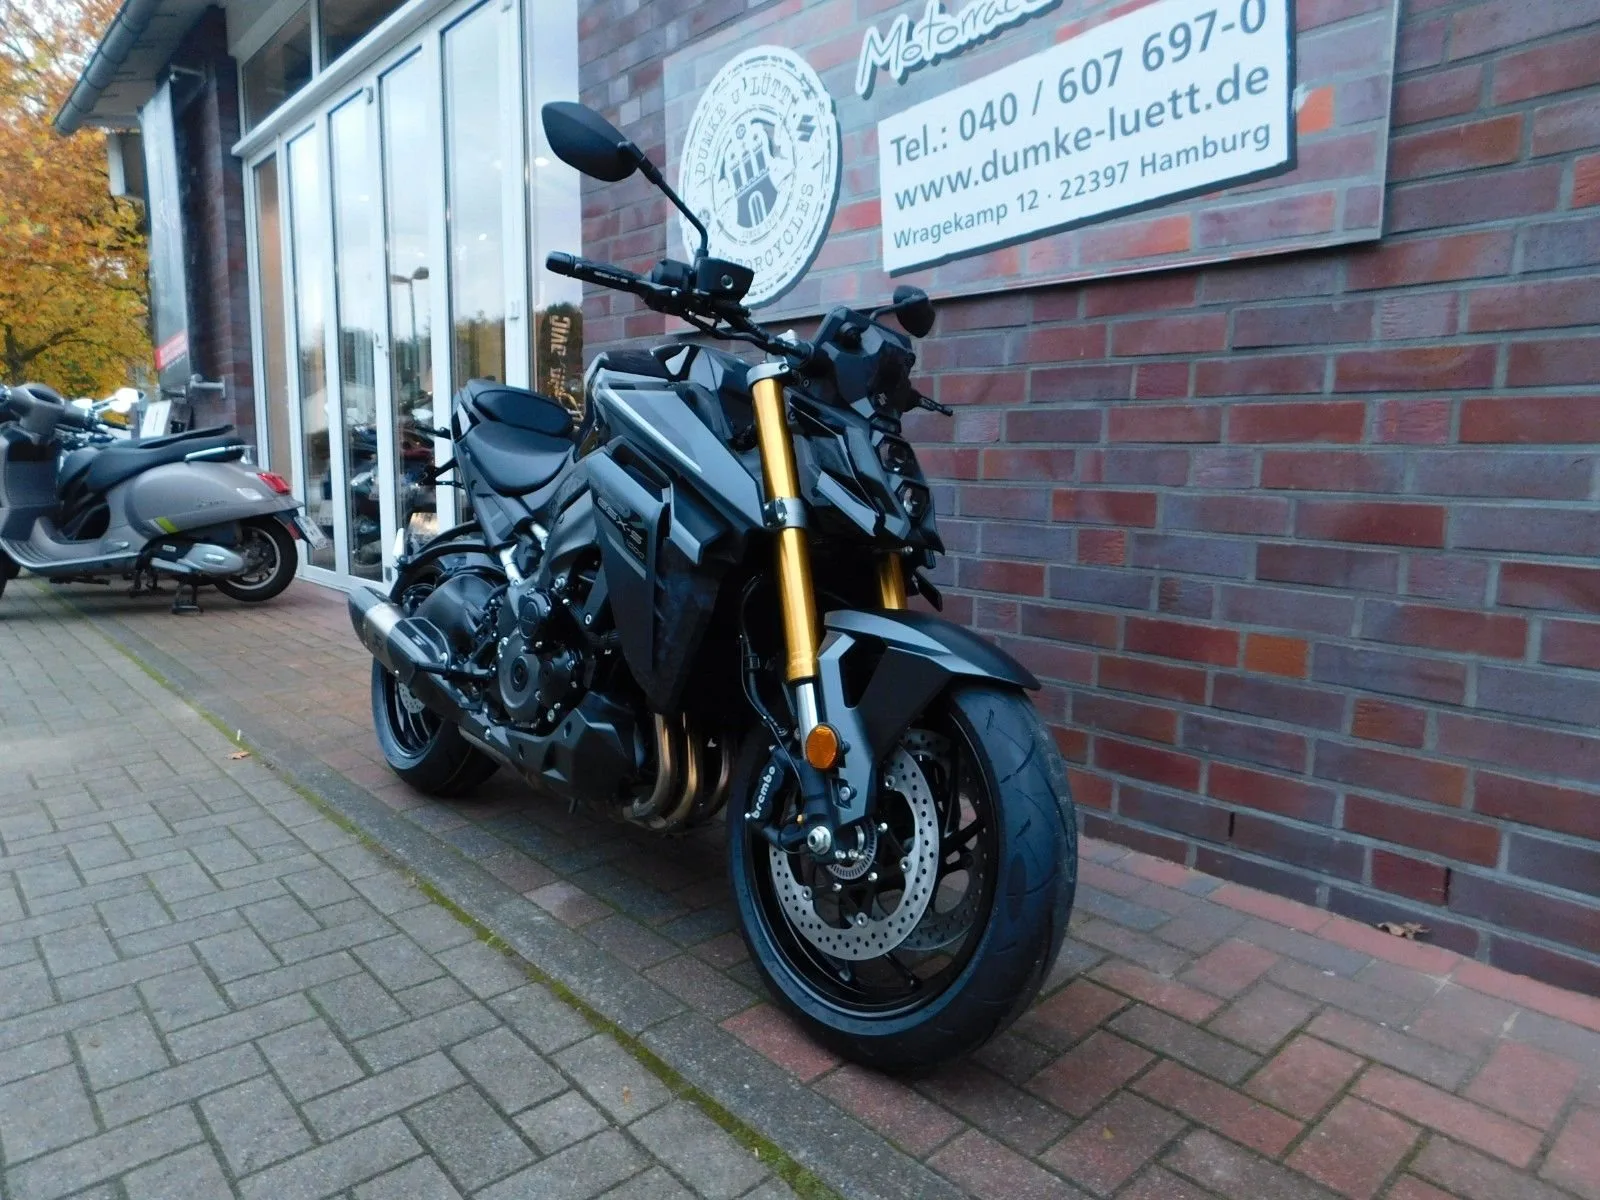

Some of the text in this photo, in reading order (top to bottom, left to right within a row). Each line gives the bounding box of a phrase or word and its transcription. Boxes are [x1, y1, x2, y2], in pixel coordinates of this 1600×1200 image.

[694, 102, 726, 176] DUMKE
[748, 72, 792, 105] LÜTT
[890, 124, 947, 166] Tel.:
[959, 92, 1018, 141] 040
[1032, 79, 1043, 116] /
[1058, 48, 1123, 104] 607
[894, 62, 1269, 211] www.dumke-luett.de
[718, 183, 814, 274] ORCYCLES
[893, 203, 1008, 249] Wragekamp
[1017, 189, 1040, 212] 12
[1060, 160, 1129, 201] 22397
[1140, 123, 1270, 177] Hamburg
[751, 765, 776, 819] brembo
